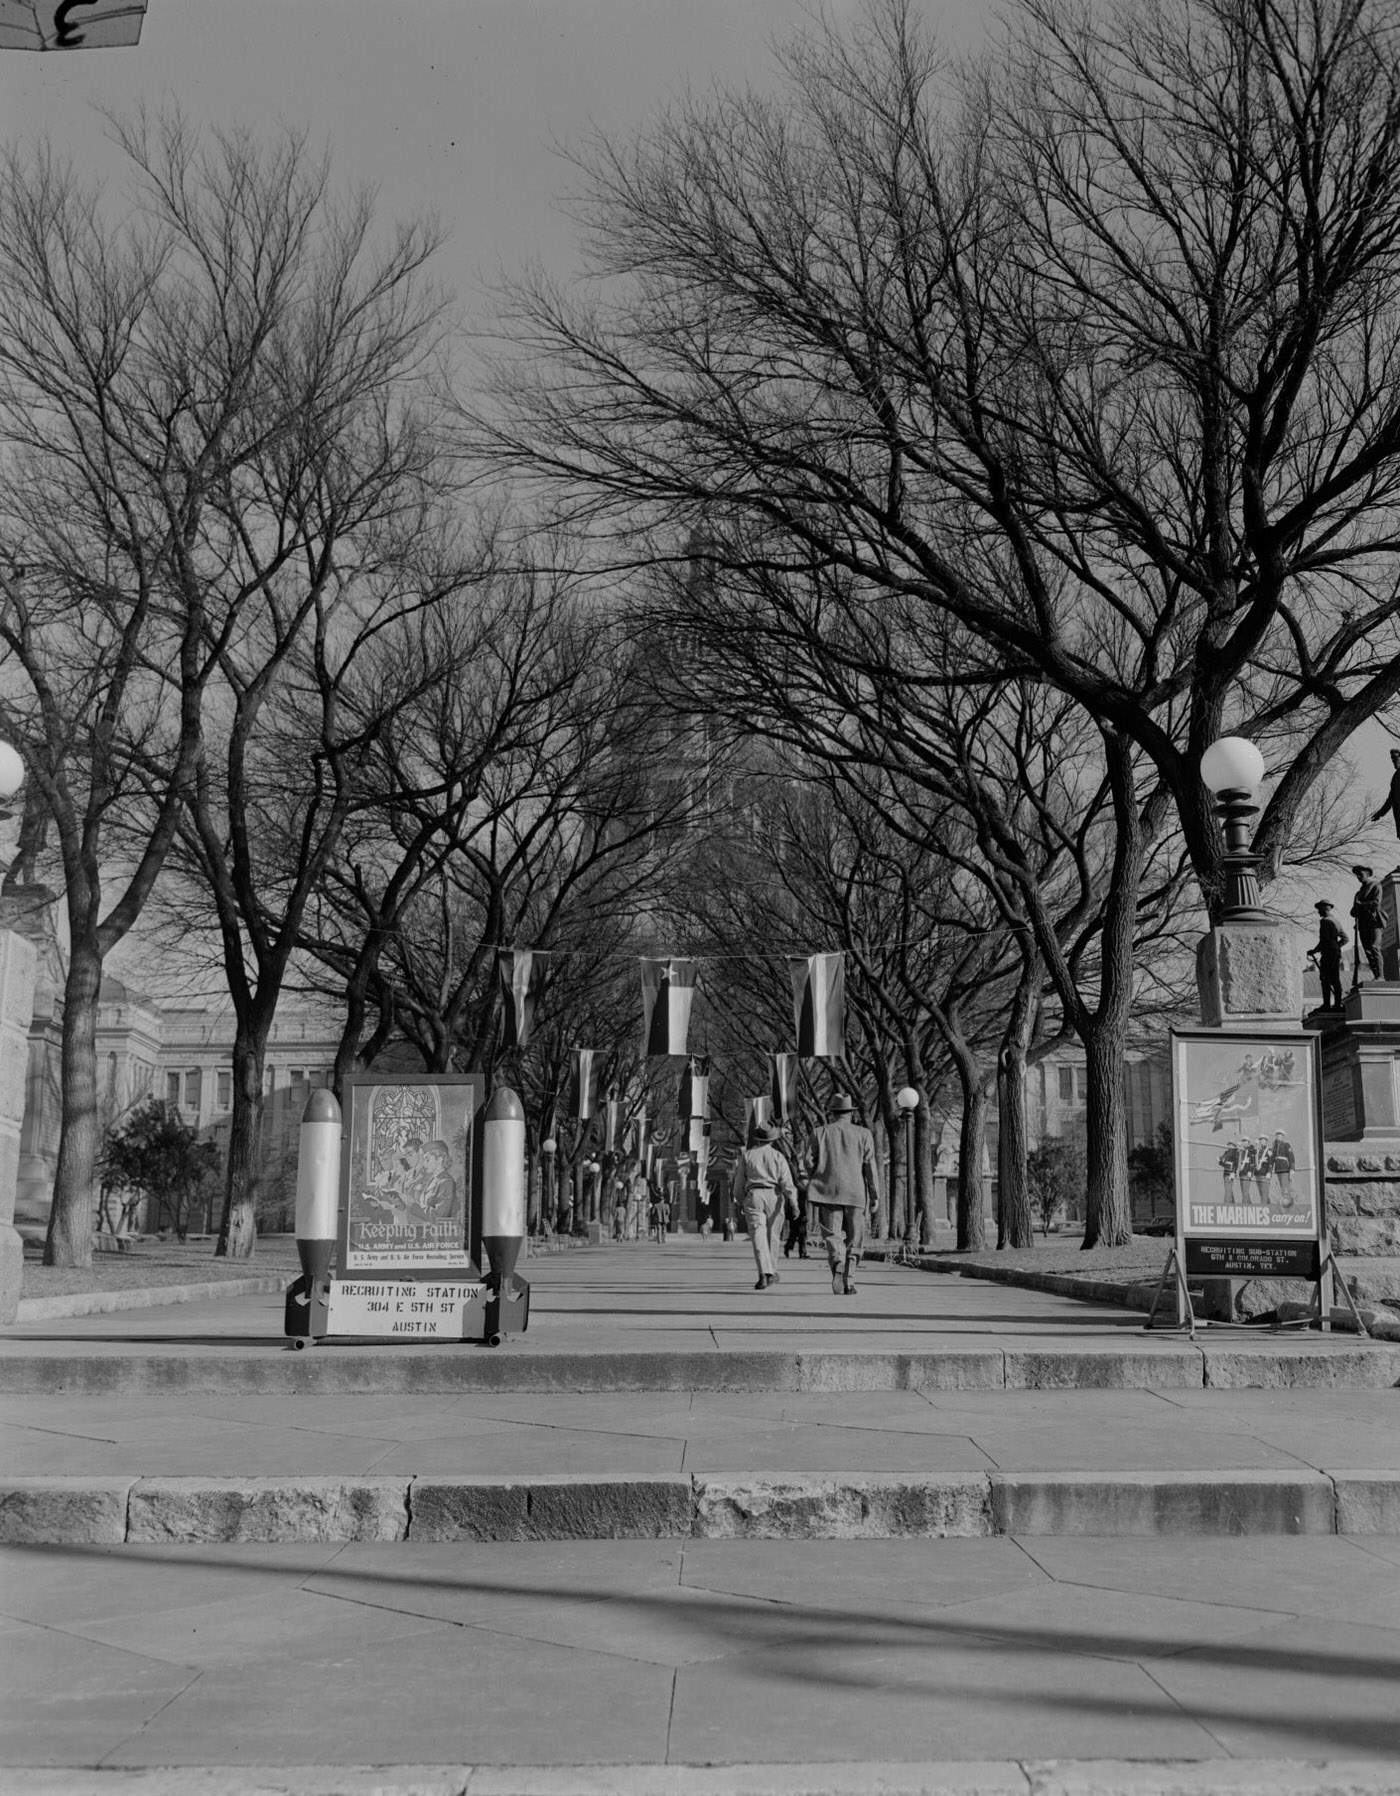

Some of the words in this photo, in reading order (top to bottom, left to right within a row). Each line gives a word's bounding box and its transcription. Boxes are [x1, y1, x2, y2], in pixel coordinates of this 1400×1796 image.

[1192, 1205, 1214, 1224] THE
[1216, 1206, 1270, 1225] MARINES
[1271, 1213, 1294, 1225] carry
[1294, 1210, 1312, 1223] on!
[360, 1222, 417, 1242] Keeping
[421, 1222, 458, 1239] Faith
[1201, 1246, 1245, 1254] RECRUITING
[1248, 1248, 1297, 1257] SUB-STATION
[1236, 1254, 1272, 1262] COLORADO
[1276, 1256, 1290, 1264] ST.
[341, 1285, 416, 1297] RECRUITING
[427, 1287, 479, 1299] STATION
[366, 1301, 389, 1312] 304
[396, 1302, 404, 1313] E
[410, 1302, 434, 1313] 5TH
[440, 1303, 455, 1314] ST
[392, 1321, 437, 1333] AUSTIN
